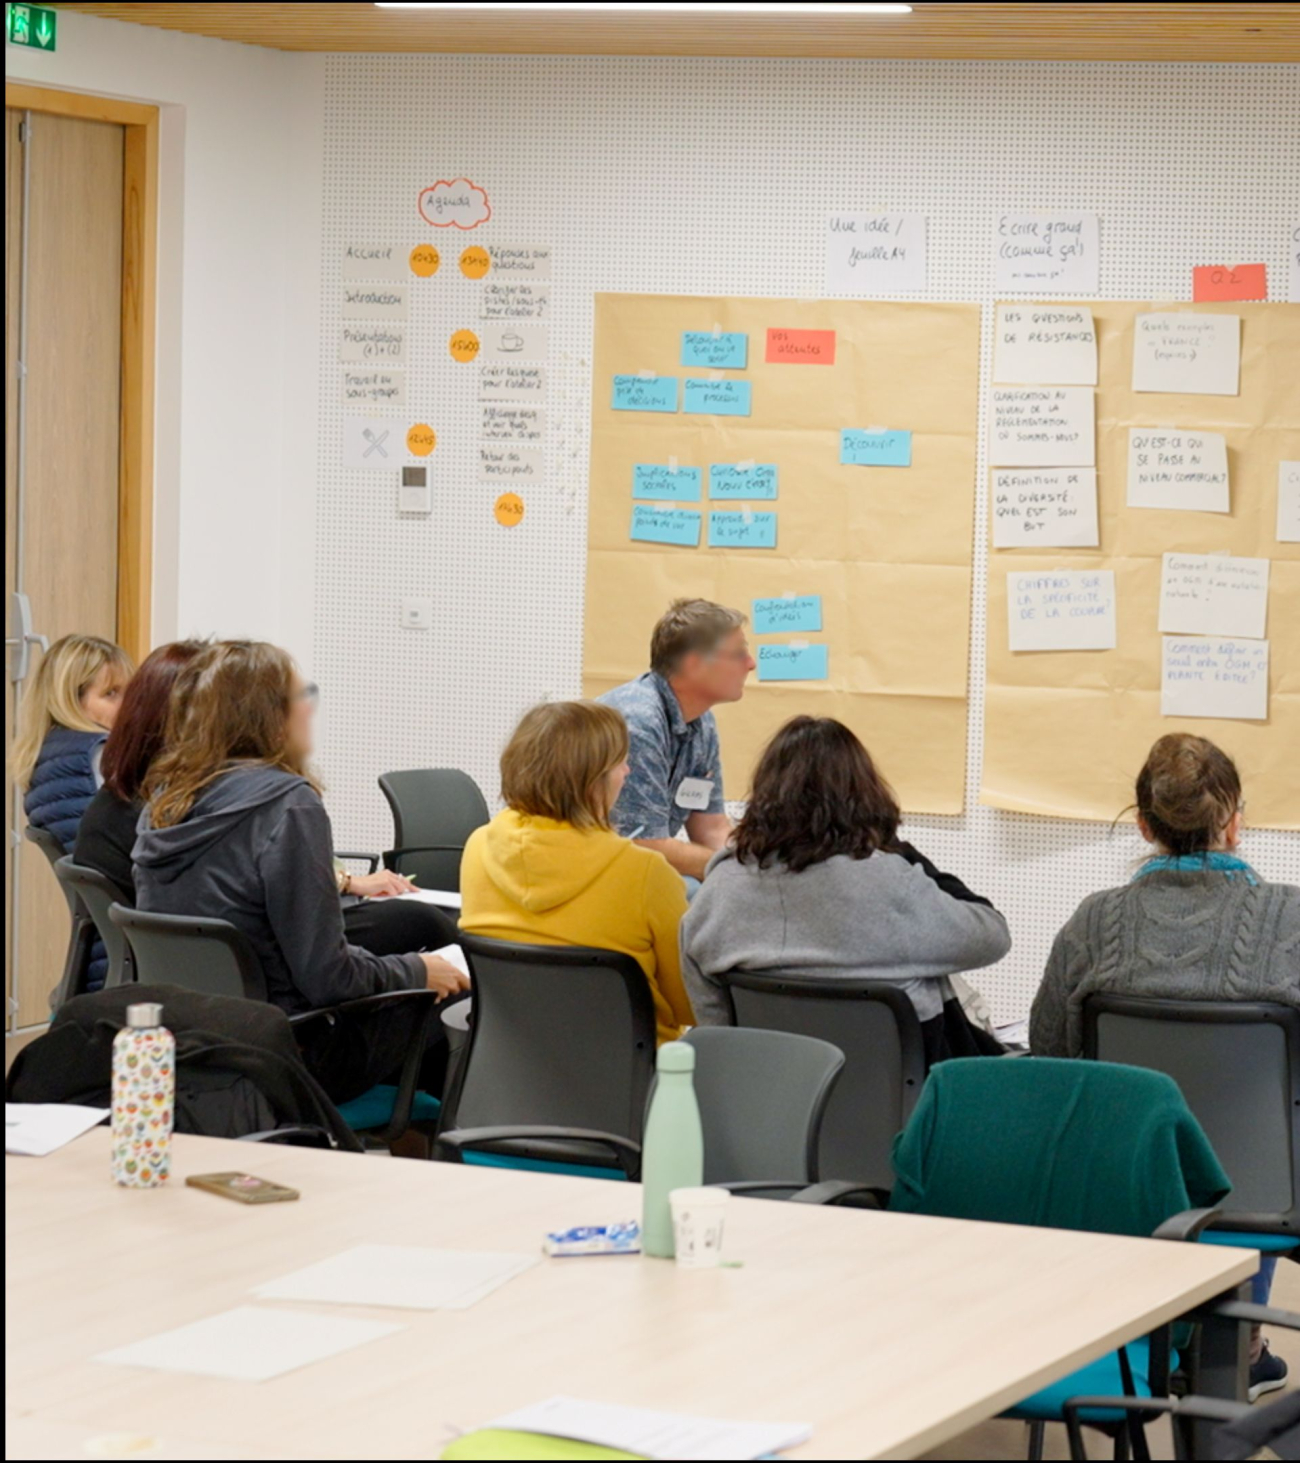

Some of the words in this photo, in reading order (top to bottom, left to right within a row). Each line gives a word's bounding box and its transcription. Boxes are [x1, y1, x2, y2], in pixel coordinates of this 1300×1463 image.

[830, 218, 856, 233] Une
[864, 217, 890, 234] idée
[1043, 219, 1082, 244] grand
[346, 247, 392, 259] Accueil
[1004, 333, 1016, 343] DE
[1026, 507, 1047, 518] EST
[1058, 506, 1077, 517] SON
[1023, 521, 1046, 532] BUT
[1046, 608, 1059, 618] LA
